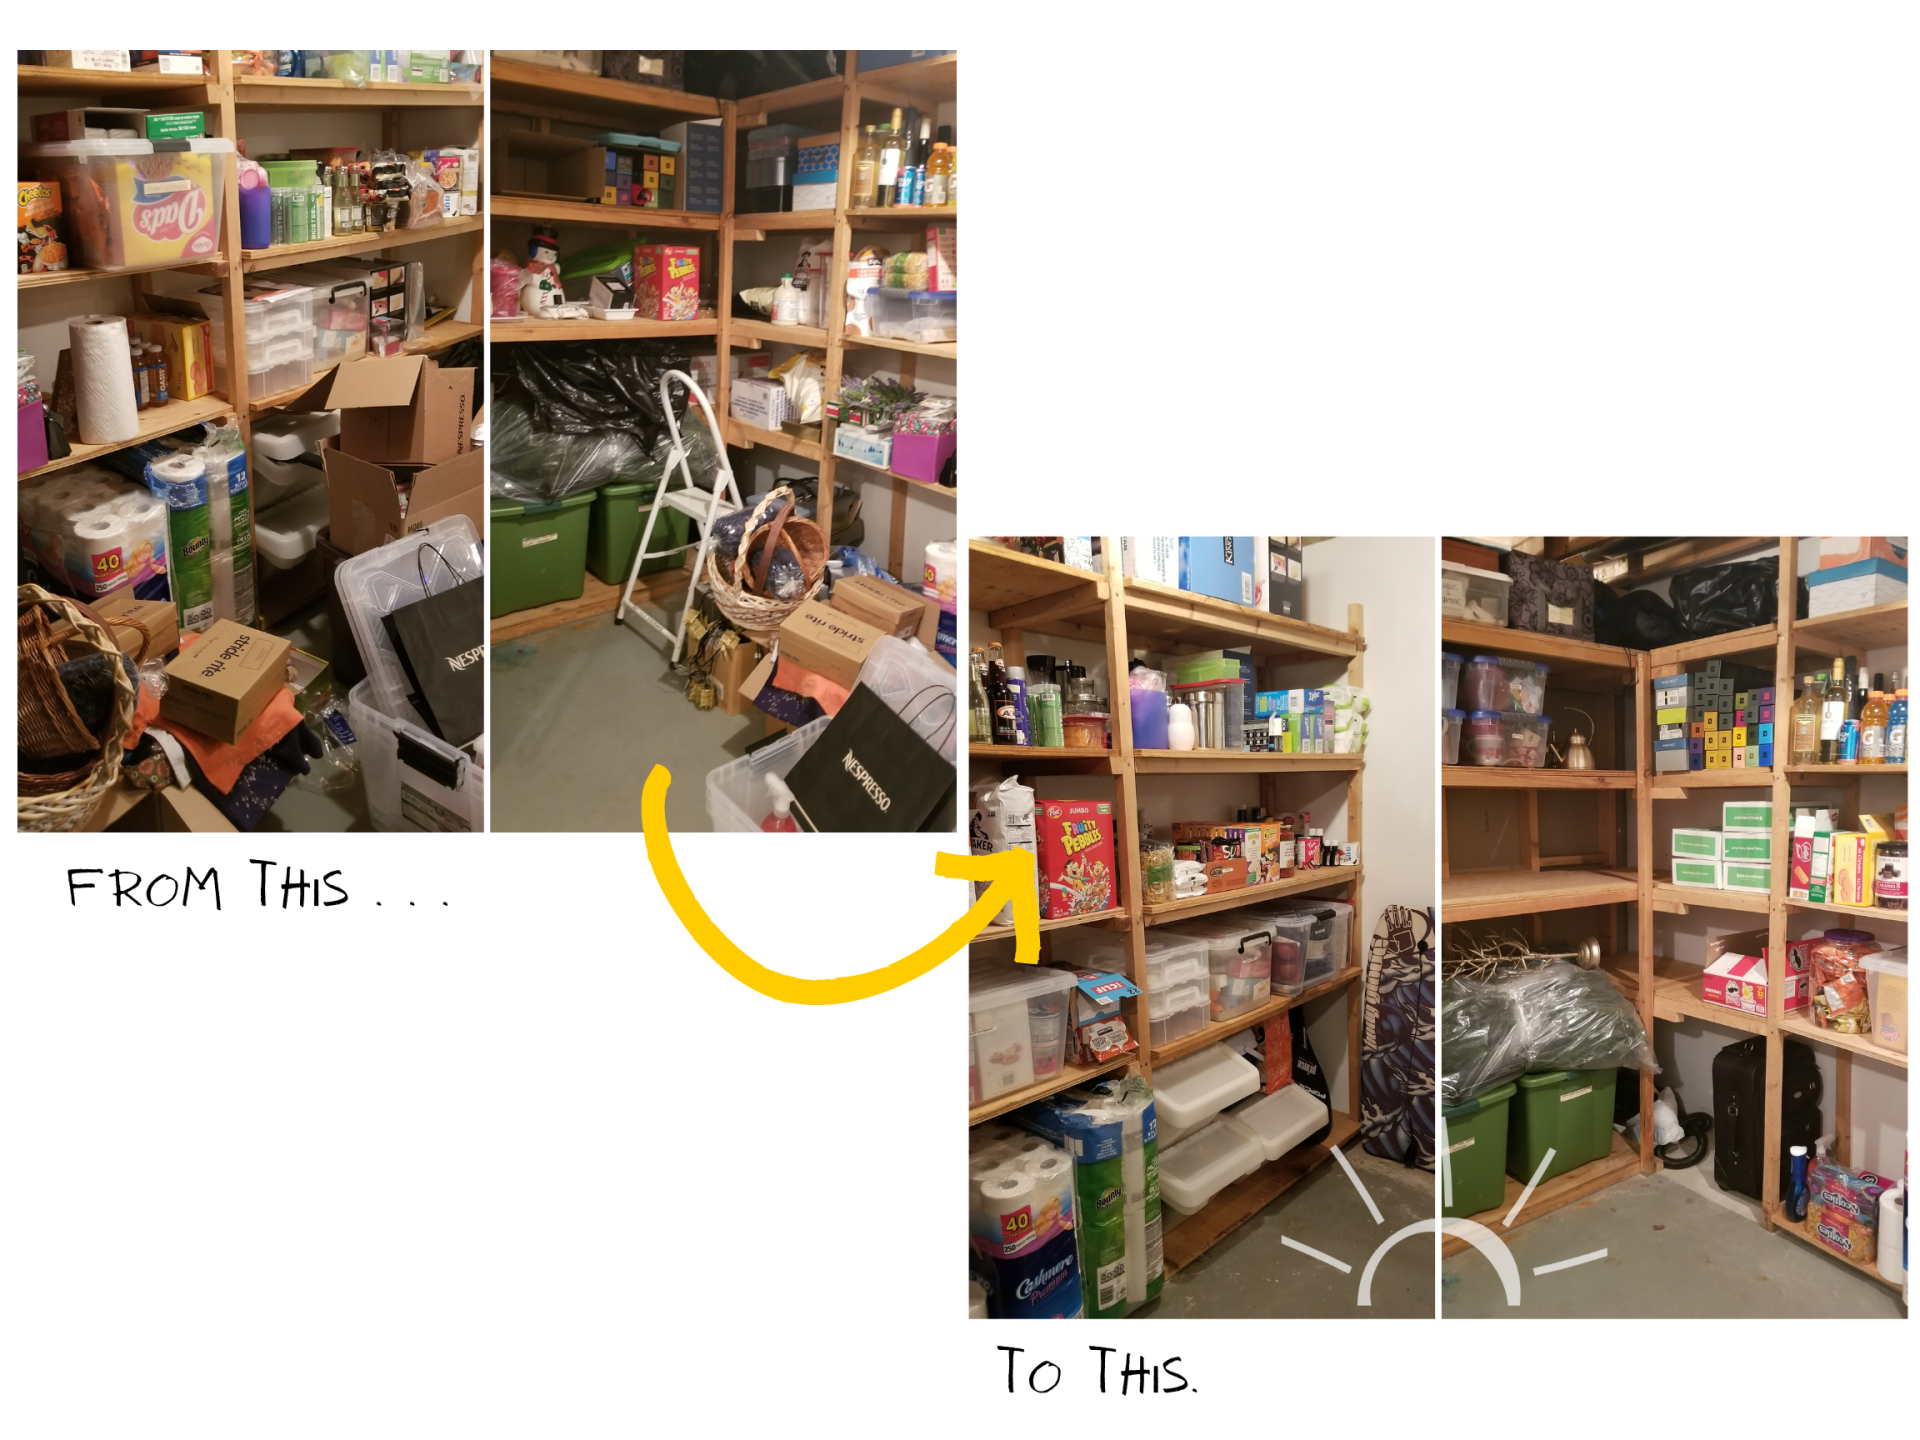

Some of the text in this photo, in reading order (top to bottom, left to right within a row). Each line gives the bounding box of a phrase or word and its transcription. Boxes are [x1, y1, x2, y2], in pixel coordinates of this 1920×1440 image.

[18, 184, 52, 207] Cheetos
[139, 189, 204, 234] Dad's
[457, 393, 466, 455] NESPRESSO
[235, 471, 247, 482] 12
[182, 536, 209, 557] Bounty
[97, 553, 120, 572] 40
[95, 583, 108, 591] 250
[804, 613, 866, 644] stride rite
[201, 634, 251, 677] stride rite
[1308, 691, 1320, 702] Ziploc
[1862, 730, 1874, 745] G
[1890, 729, 1903, 744] G
[841, 748, 891, 811] NESPRESSO
[1049, 807, 1060, 817] Post
[1061, 819, 1097, 836] FRUITY
[1060, 828, 1103, 857] PEBBLES
[1096, 983, 1117, 994] CLIF
[1096, 1187, 1122, 1210] Bounty
[1823, 1190, 1859, 1215] Scotties
[1006, 1212, 1029, 1232] 40
[1819, 1224, 1852, 1250] Scotties
[1004, 1244, 1016, 1253] 250
[1016, 1254, 1074, 1300] Cashmere
[1030, 1269, 1068, 1306] Premium
